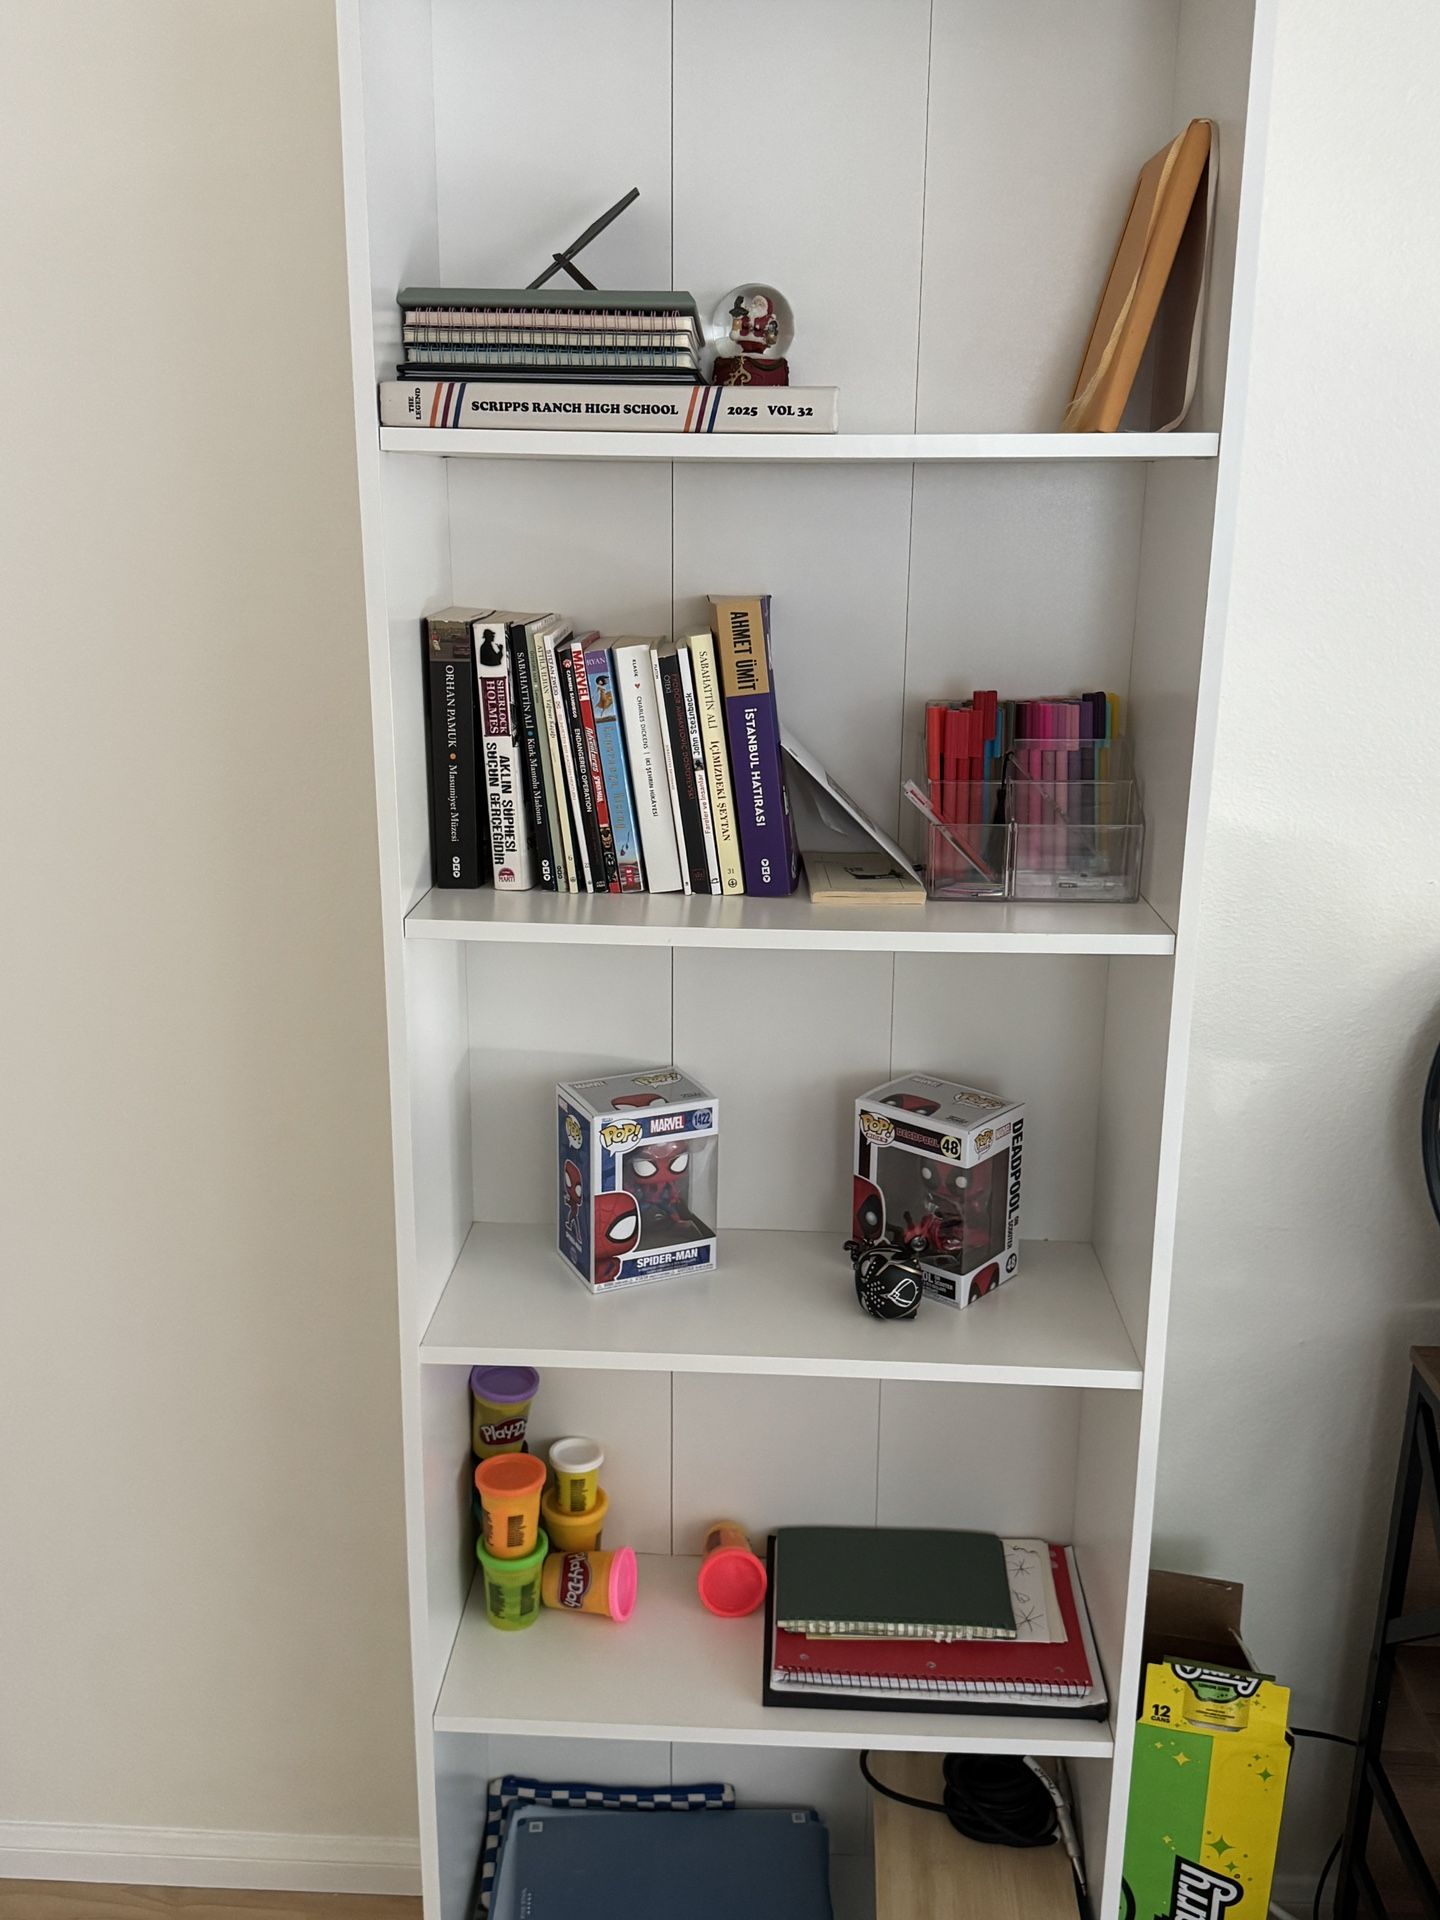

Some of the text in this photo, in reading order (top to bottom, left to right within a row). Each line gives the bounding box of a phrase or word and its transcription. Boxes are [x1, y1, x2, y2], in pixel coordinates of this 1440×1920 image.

[471, 401, 679, 415] SCRIPPS RANCH HIGH SCHOOL
[727, 406, 758, 417] 2025
[767, 405, 814, 417] VOL 32
[547, 649, 559, 696] STEFAN ZWEIG
[572, 650, 588, 698] MARVEL
[587, 656, 605, 667] RYAN
[730, 611, 759, 691] AHMET ÜMİT
[445, 664, 457, 748] ORHAN PAMUK
[486, 680, 499, 734] HOLMES
[496, 679, 508, 733] SHERLOCK
[516, 652, 531, 712] SABAHATTİN
[526, 713, 535, 729] ALİ
[566, 669, 578, 719] CARMEN SANDIEGO
[699, 651, 718, 729] SABAHATTİN ALİ
[636, 695, 649, 750] CHARLES DICKENS
[685, 692, 701, 756] John Steinbeck
[486, 742, 499, 787] SUÇUN
[527, 738, 542, 825] Kürk Mantolu Madonna
[574, 728, 592, 813] ENDANGERED OPERATION
[744, 708, 766, 827] İSTANBUL HATIRASI
[448, 764, 460, 842] Masumiyet Müzesi
[499, 755, 517, 853] AKLIN ŞÜPHESİ
[700, 801, 707, 810] ve
[701, 810, 712, 834] Fareler
[717, 802, 731, 841] ŞEYTAN
[650, 1115, 685, 1133] MARVEL
[693, 1112, 712, 1128] 1422
[942, 1138, 959, 1155] 48
[1008, 1117, 1024, 1219] DEADPOOL
[636, 1248, 699, 1269] SPIDER-MAN
[481, 1418, 527, 1442] Play-D
[1150, 1715, 1170, 1724] CANS
[1152, 1703, 1171, 1718] 12
